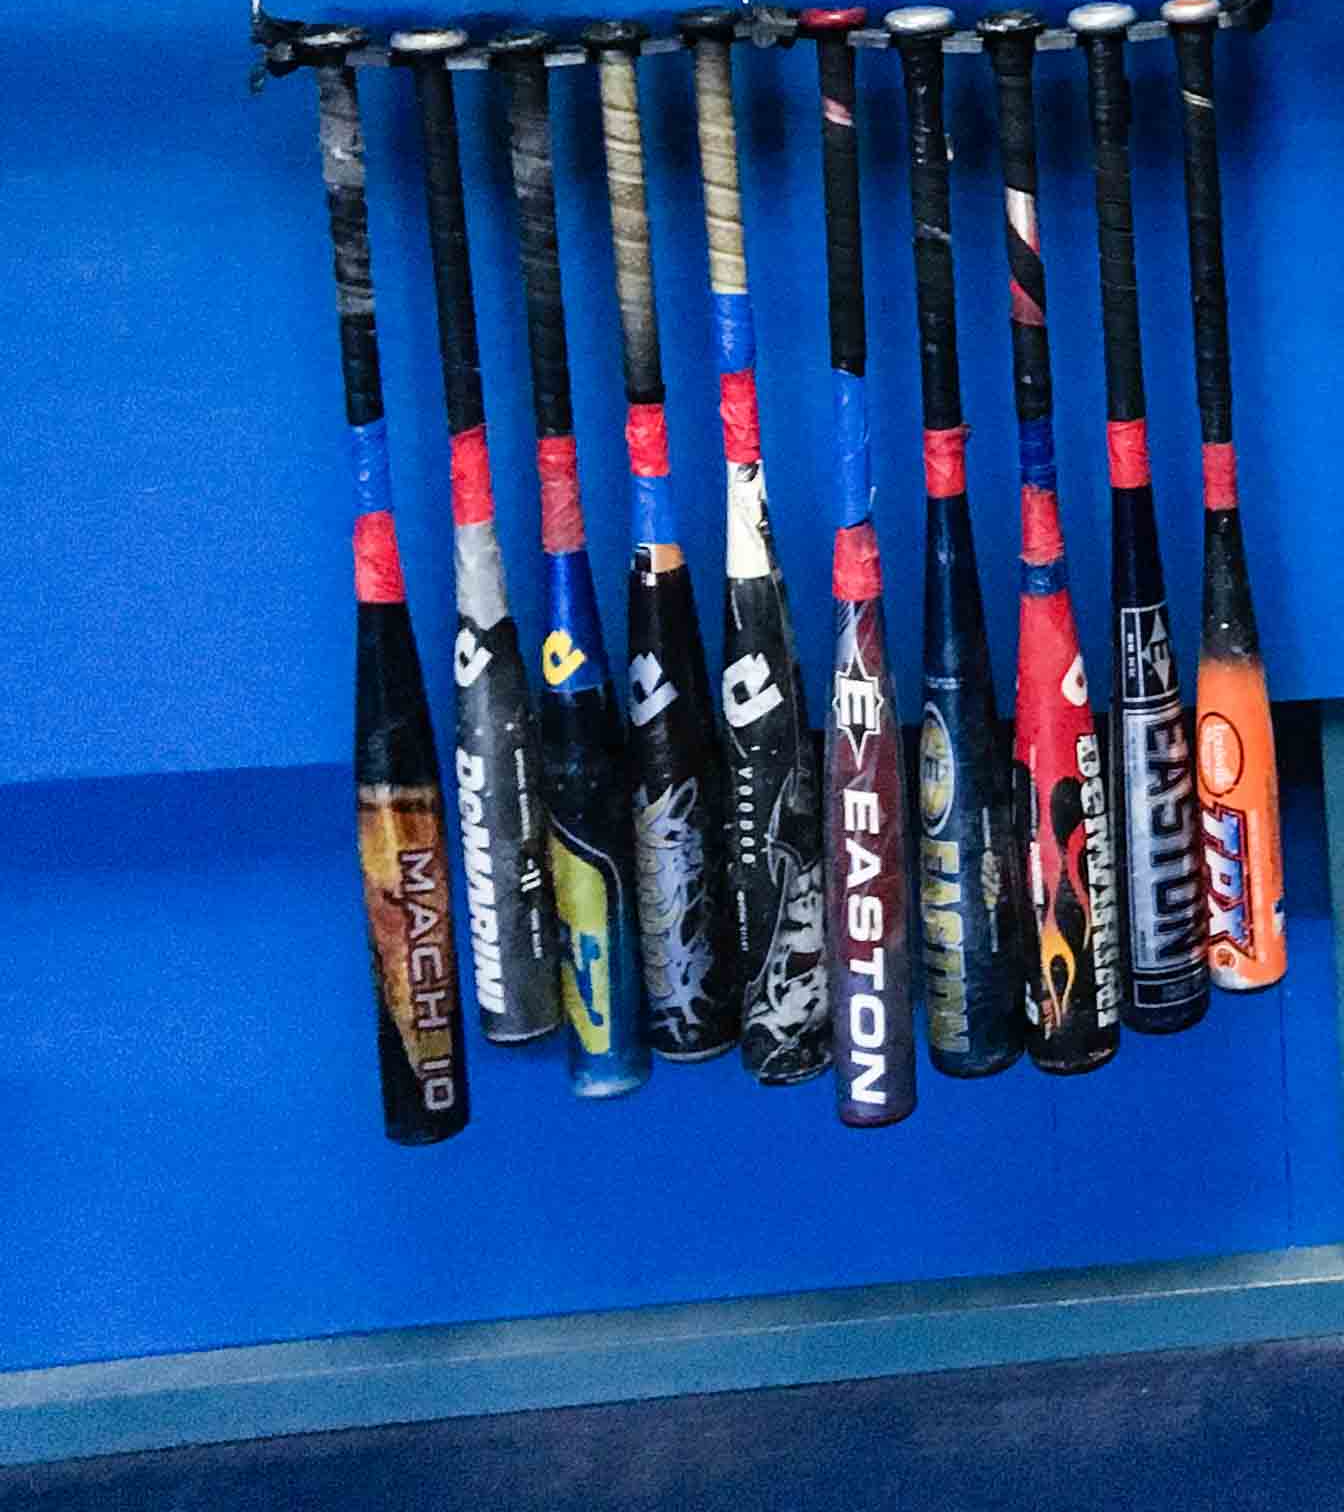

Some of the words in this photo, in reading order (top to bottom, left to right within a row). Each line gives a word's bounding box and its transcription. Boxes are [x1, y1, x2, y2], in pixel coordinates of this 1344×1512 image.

[399, 850, 450, 1029] MACH
[1147, 714, 1197, 964] EASTON
[1202, 809, 1252, 953] TPX
[842, 788, 888, 1105] EASTON
